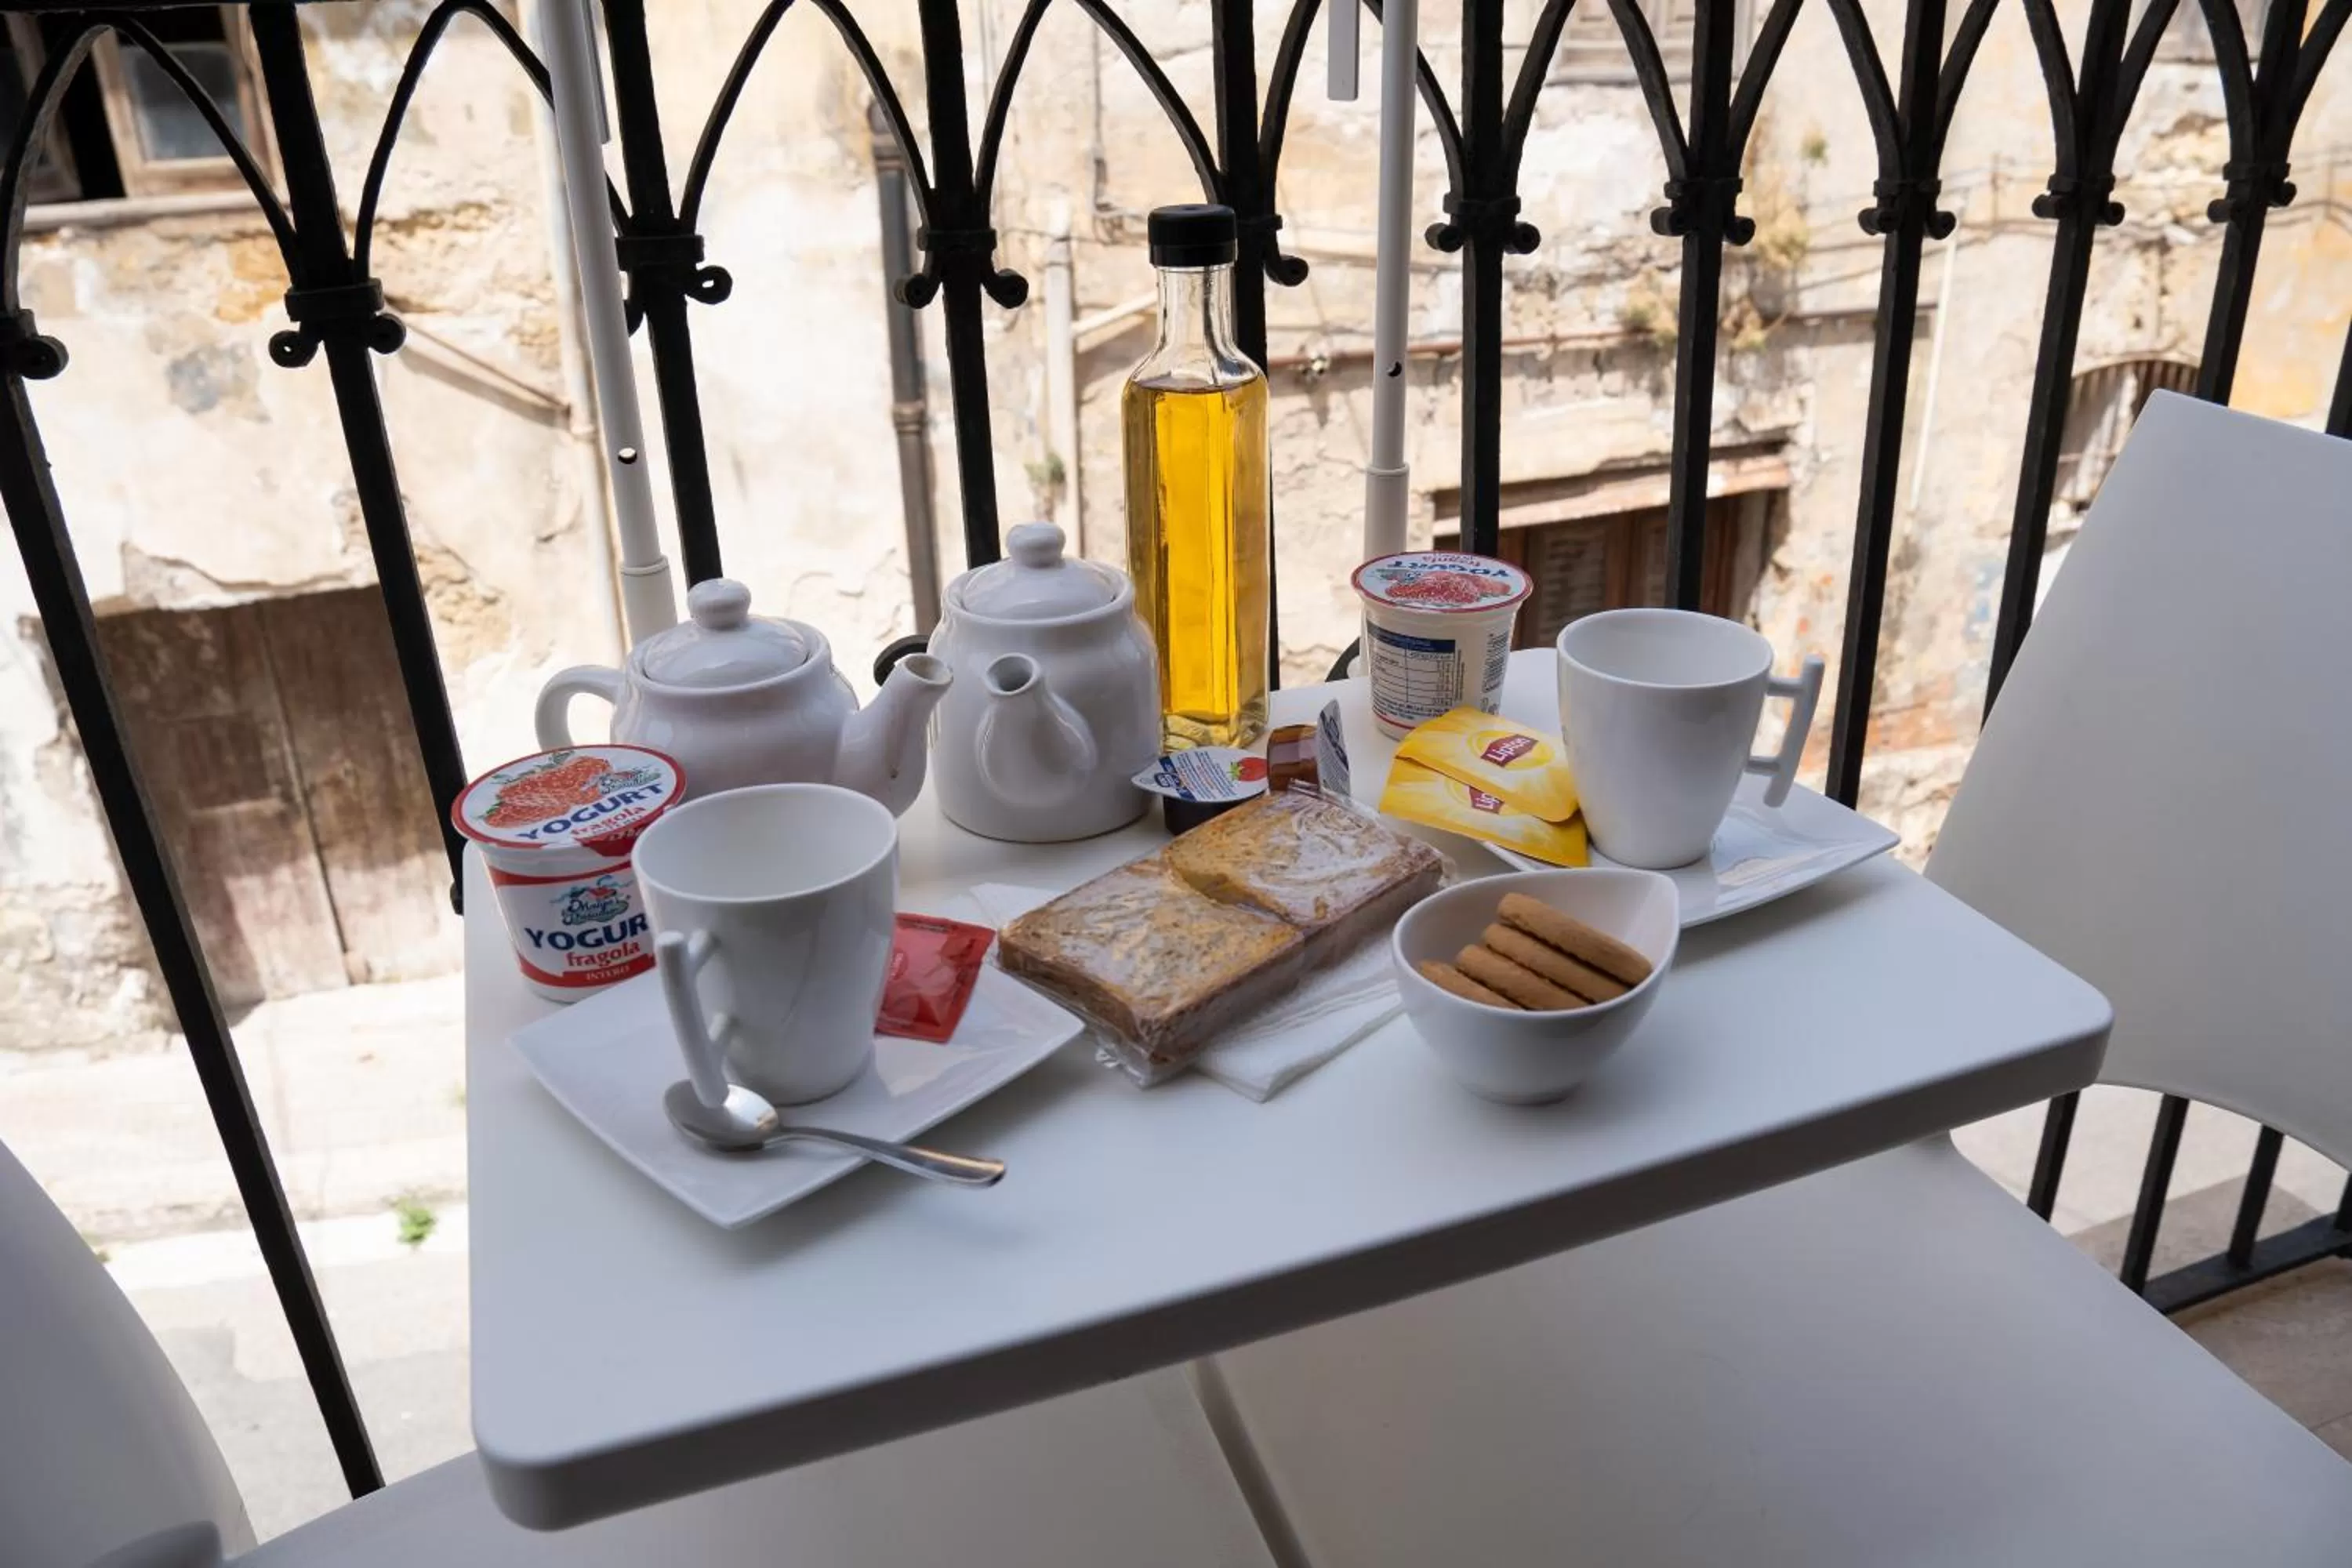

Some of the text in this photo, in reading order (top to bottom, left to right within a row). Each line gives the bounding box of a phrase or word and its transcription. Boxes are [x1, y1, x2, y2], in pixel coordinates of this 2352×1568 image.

[1387, 561, 1509, 577] YOGURT
[1486, 738, 1531, 762] Lipton
[516, 783, 663, 840] YOGURT
[571, 807, 647, 835] fragola
[524, 913, 650, 951] YOGUR
[566, 942, 641, 967] fragola
